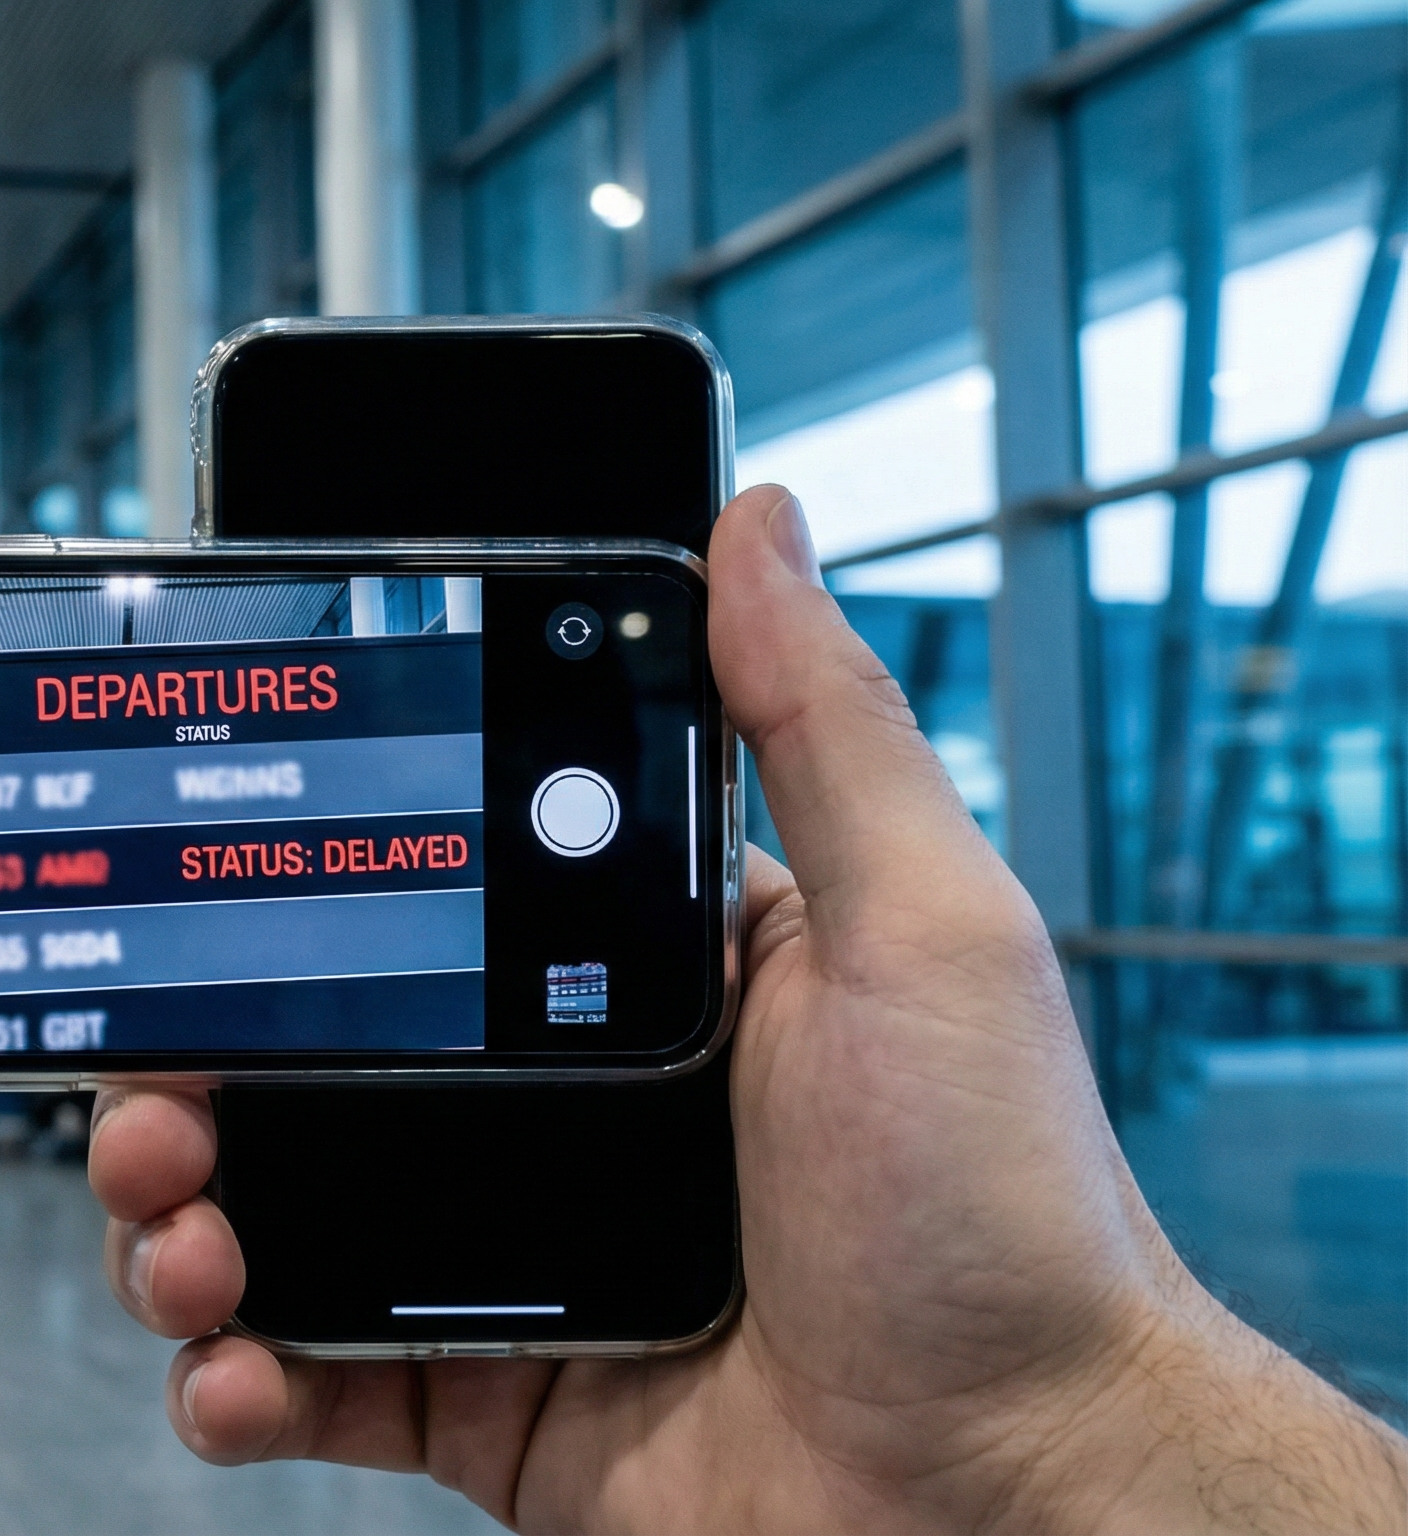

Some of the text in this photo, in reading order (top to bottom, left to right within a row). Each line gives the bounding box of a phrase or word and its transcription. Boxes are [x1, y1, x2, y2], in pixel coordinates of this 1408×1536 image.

[37, 664, 339, 721] DEPARTURES
[175, 724, 231, 742] STATUS
[181, 834, 469, 881] STATUS: DELAYED
